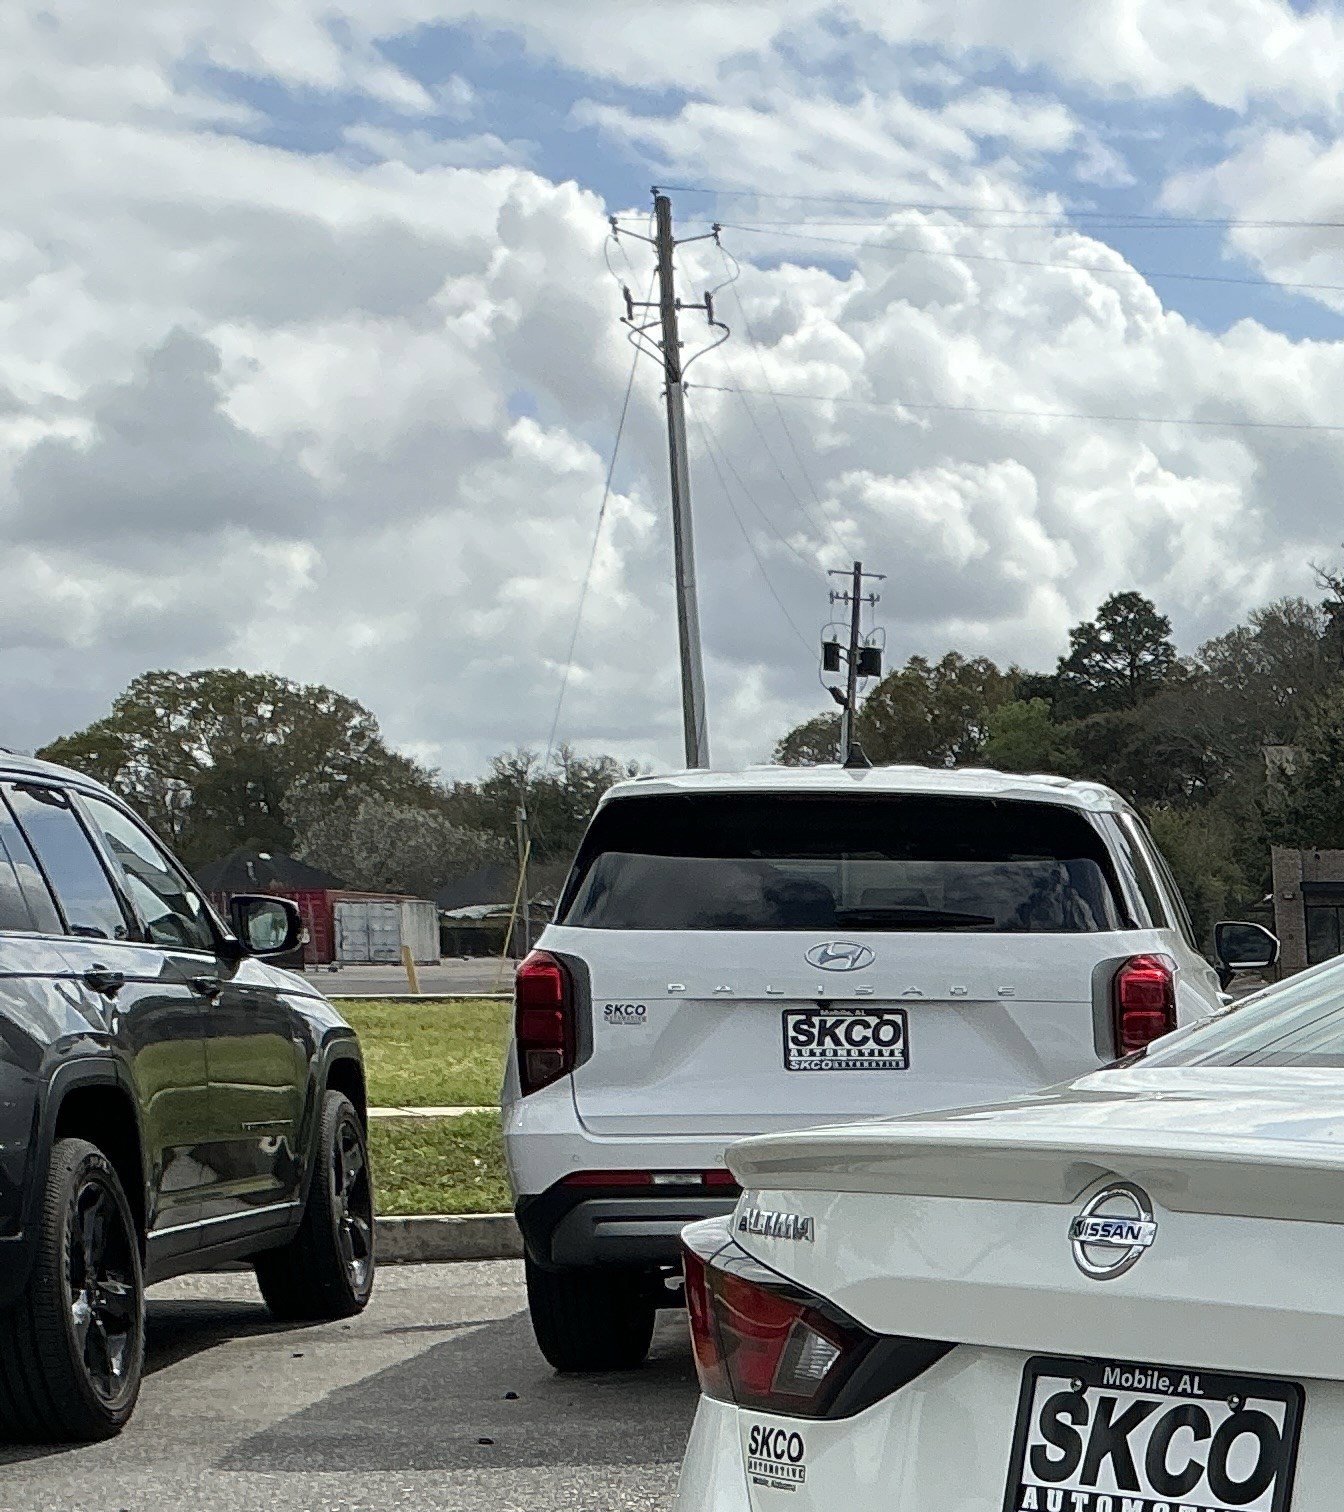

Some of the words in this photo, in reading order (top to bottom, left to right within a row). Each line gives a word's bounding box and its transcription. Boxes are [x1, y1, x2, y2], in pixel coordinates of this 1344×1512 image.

[667, 983, 1016, 996] PALISADE
[603, 1003, 647, 1016] SKCO
[790, 1018, 902, 1048] SKCO
[790, 1049, 903, 1057] AUTOMOTIVE
[790, 1060, 832, 1070] SKCO
[740, 1207, 816, 1243] ALTIMA
[1074, 1220, 1142, 1241] NISSAN
[1103, 1366, 1177, 1393] Mobile,
[1177, 1374, 1205, 1394] AL
[748, 1424, 804, 1463] SKCO
[1029, 1390, 1284, 1506] SKCO
[748, 1459, 805, 1479] AUTOMOTIVE
